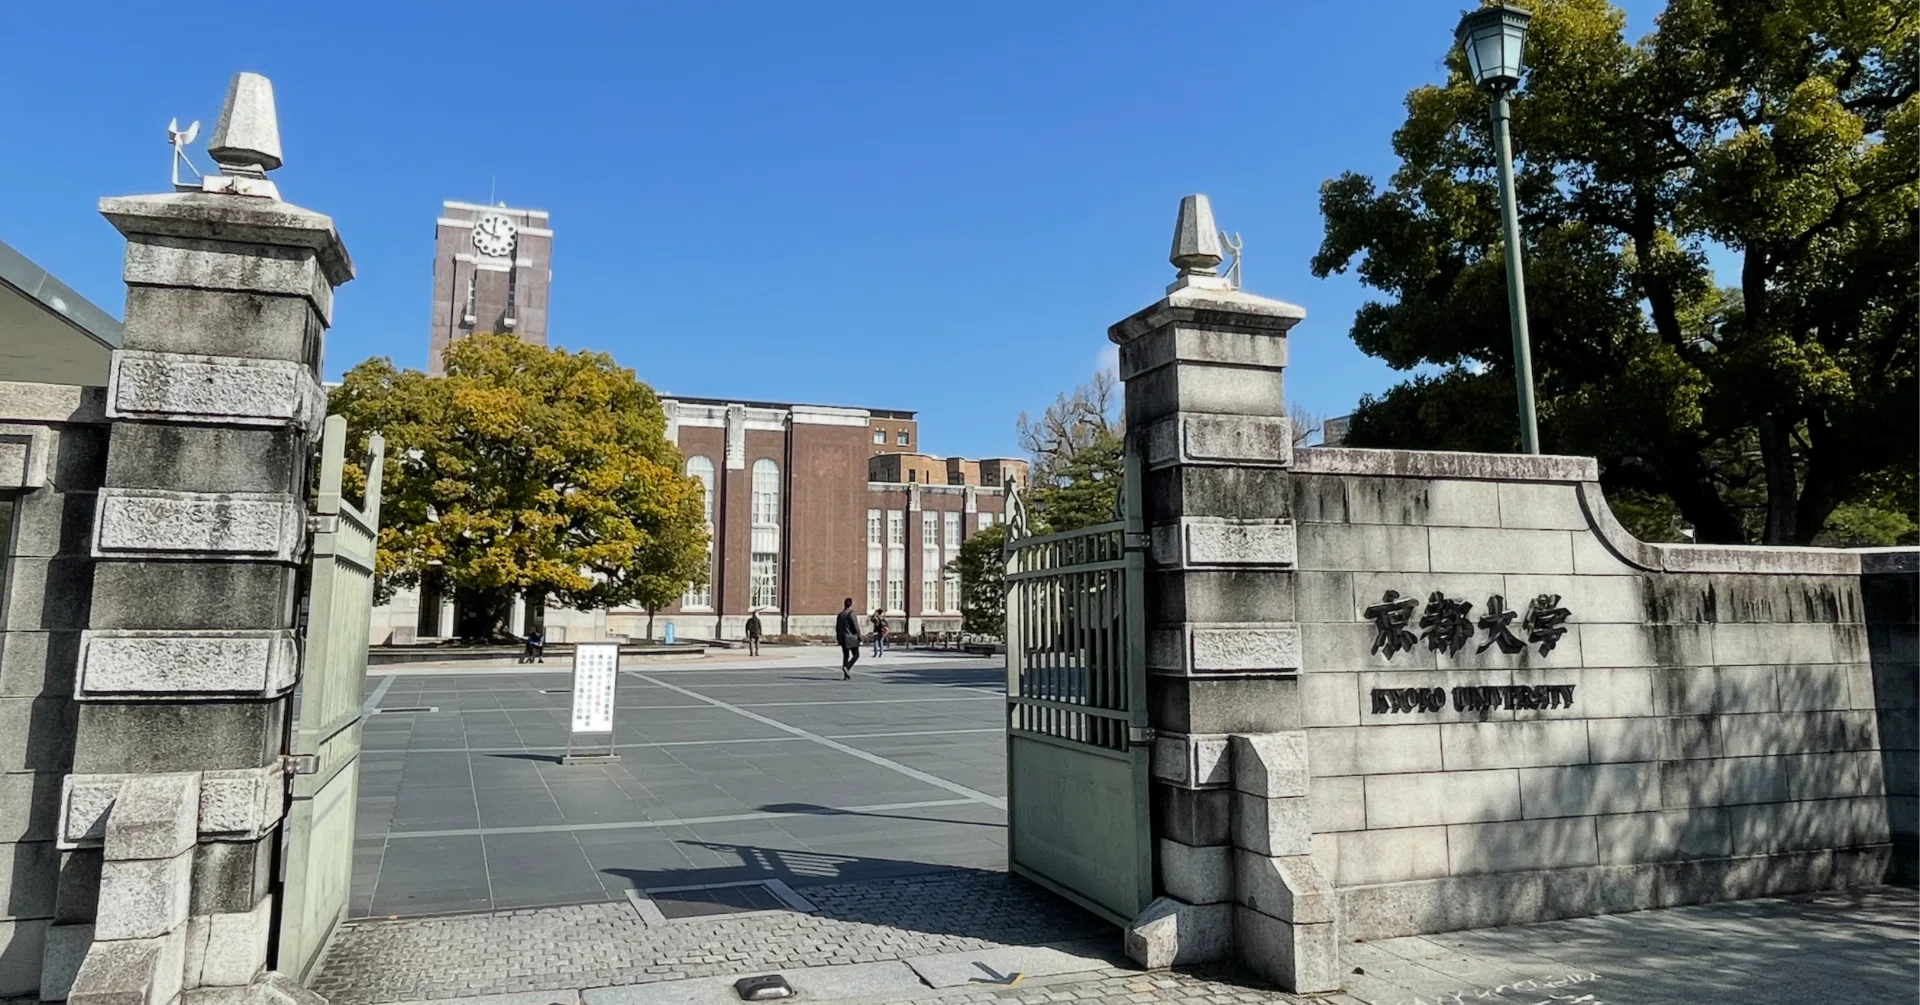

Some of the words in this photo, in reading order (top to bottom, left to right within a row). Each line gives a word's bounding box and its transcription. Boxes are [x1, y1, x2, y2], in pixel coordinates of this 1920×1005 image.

[1364, 590, 1572, 660] 京都大学
[1370, 687, 1446, 714] KYOTO
[1451, 685, 1576, 712] UNIVERSITY
